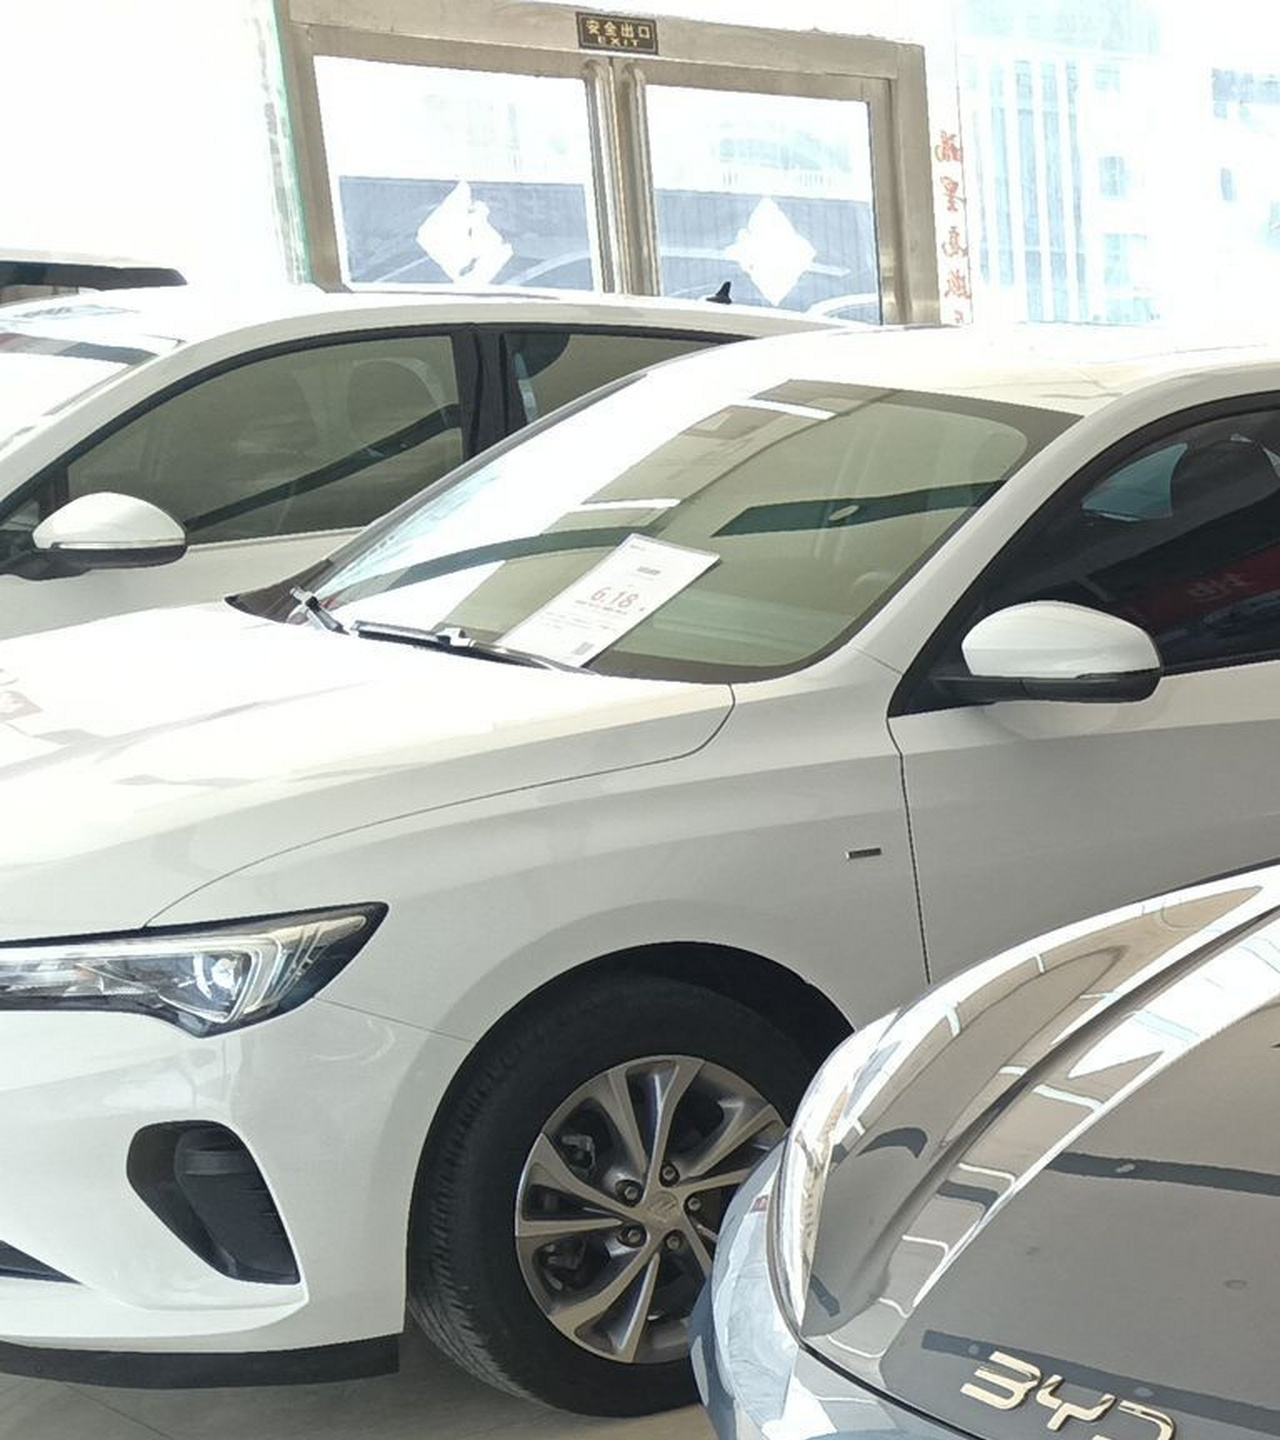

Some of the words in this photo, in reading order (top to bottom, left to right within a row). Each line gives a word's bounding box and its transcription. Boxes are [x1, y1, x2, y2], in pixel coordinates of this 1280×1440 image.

[585, 19, 651, 39] 安全出口
[597, 35, 639, 47] EXIT
[591, 586, 639, 608] 6.18
